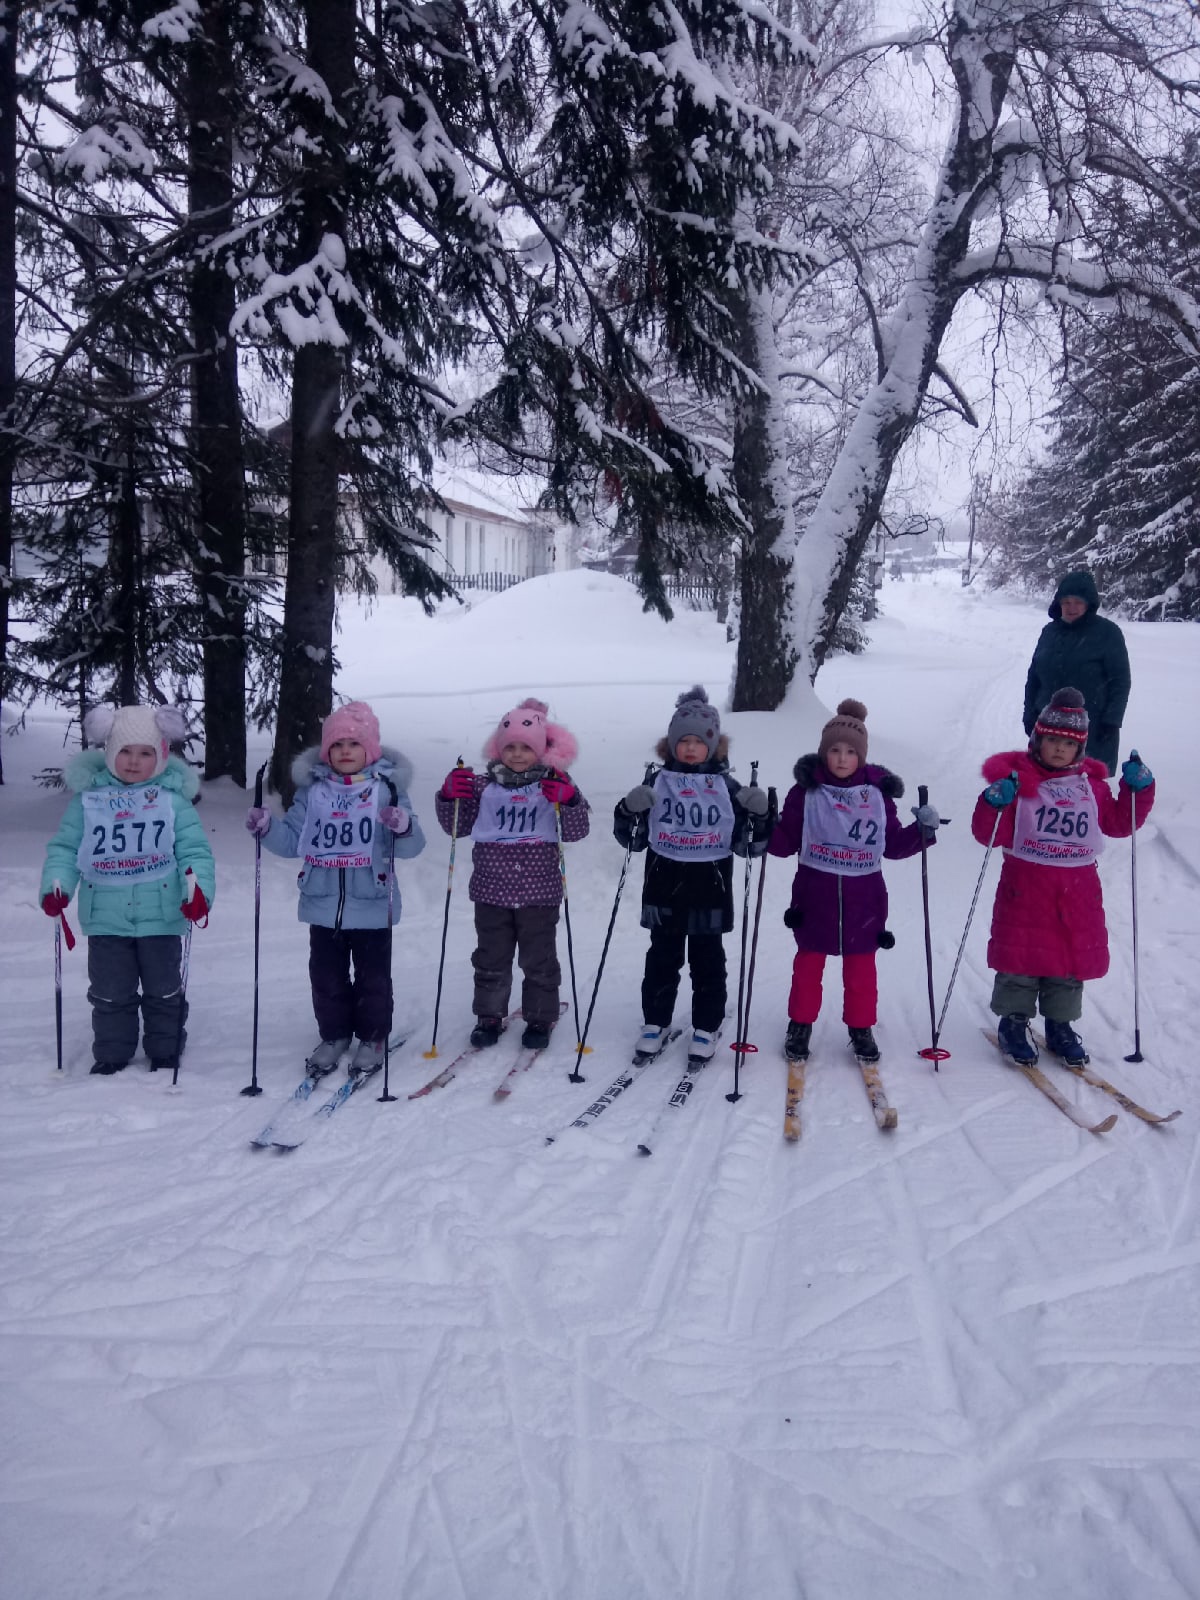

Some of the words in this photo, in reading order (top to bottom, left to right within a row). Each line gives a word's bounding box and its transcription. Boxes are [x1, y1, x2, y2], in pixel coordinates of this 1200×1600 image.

[496, 805, 537, 833] 1111
[658, 798, 721, 828] 2900
[1035, 804, 1089, 838] 1256
[92, 820, 165, 855] 2577
[848, 818, 879, 846] 42
